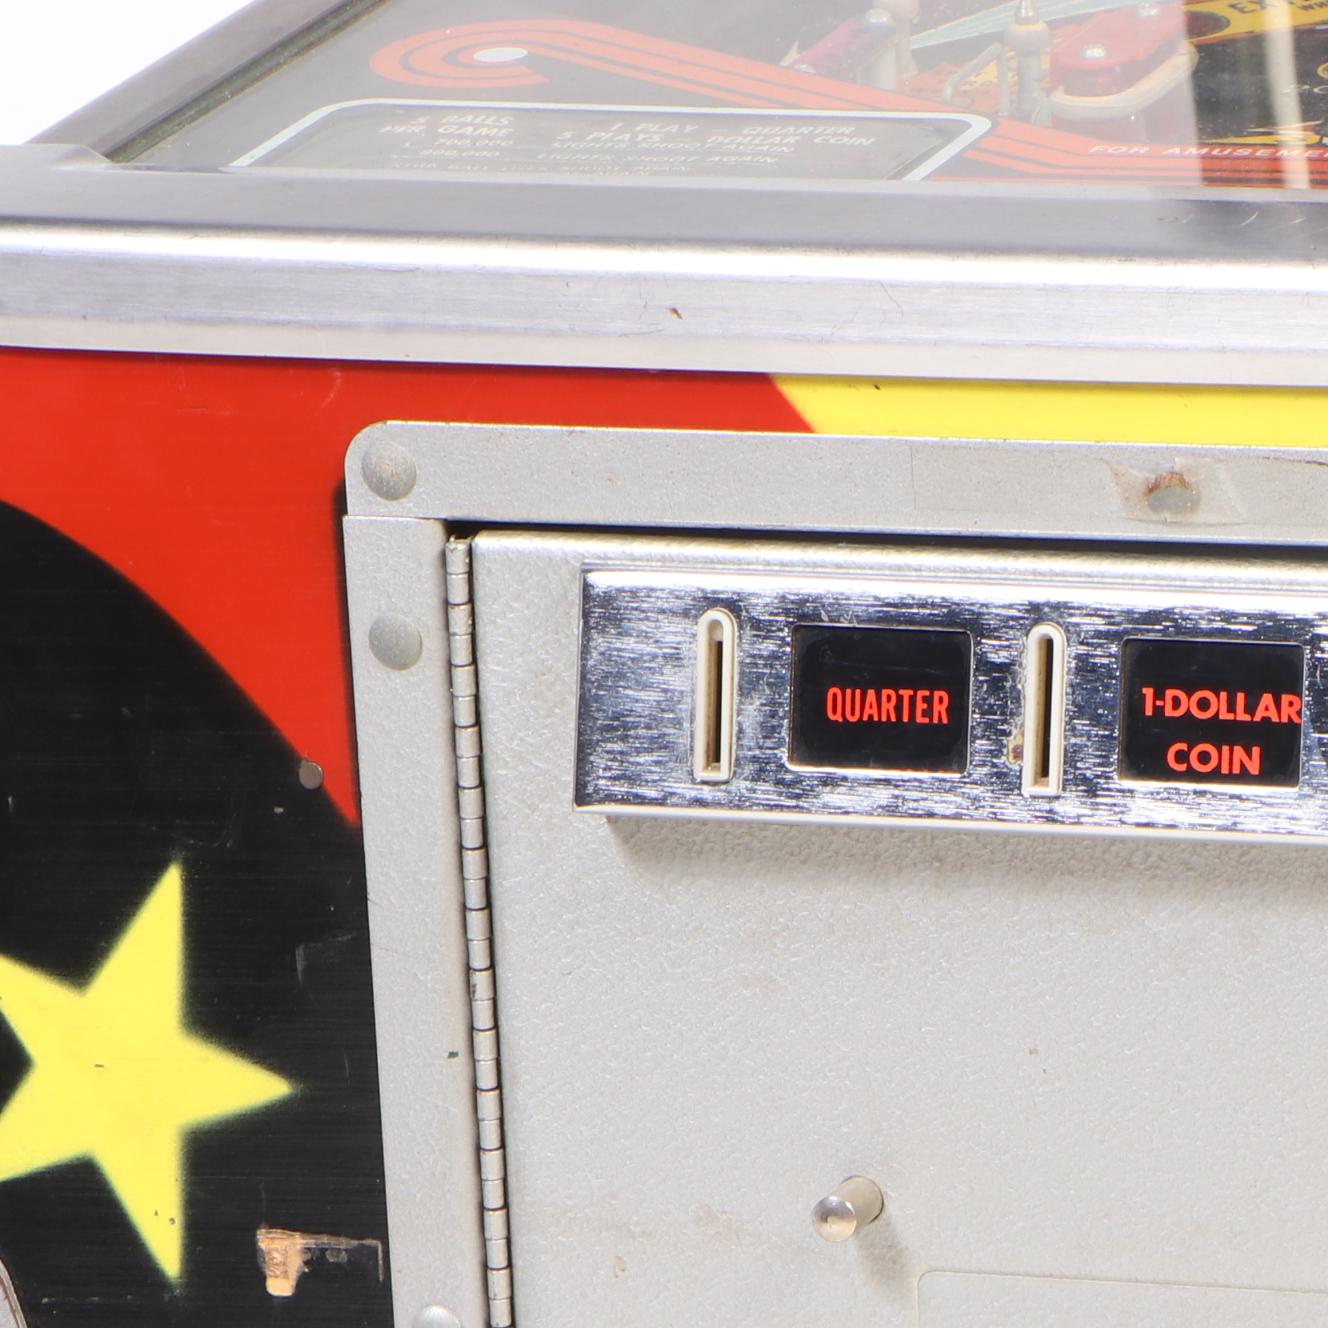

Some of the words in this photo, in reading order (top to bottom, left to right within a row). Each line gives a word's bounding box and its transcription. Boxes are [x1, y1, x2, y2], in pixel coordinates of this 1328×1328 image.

[436, 125, 515, 137] GAME
[634, 122, 701, 133] PLAY
[742, 126, 856, 135] QUARTER
[585, 132, 666, 142] PLAYS
[706, 135, 802, 144] DOLLAR
[812, 135, 876, 146] COIN
[1089, 145, 1149, 154] FOR
[826, 686, 950, 725] QUARTER
[1142, 686, 1303, 724] 1-DOLLAR
[1166, 742, 1262, 776] COIN
